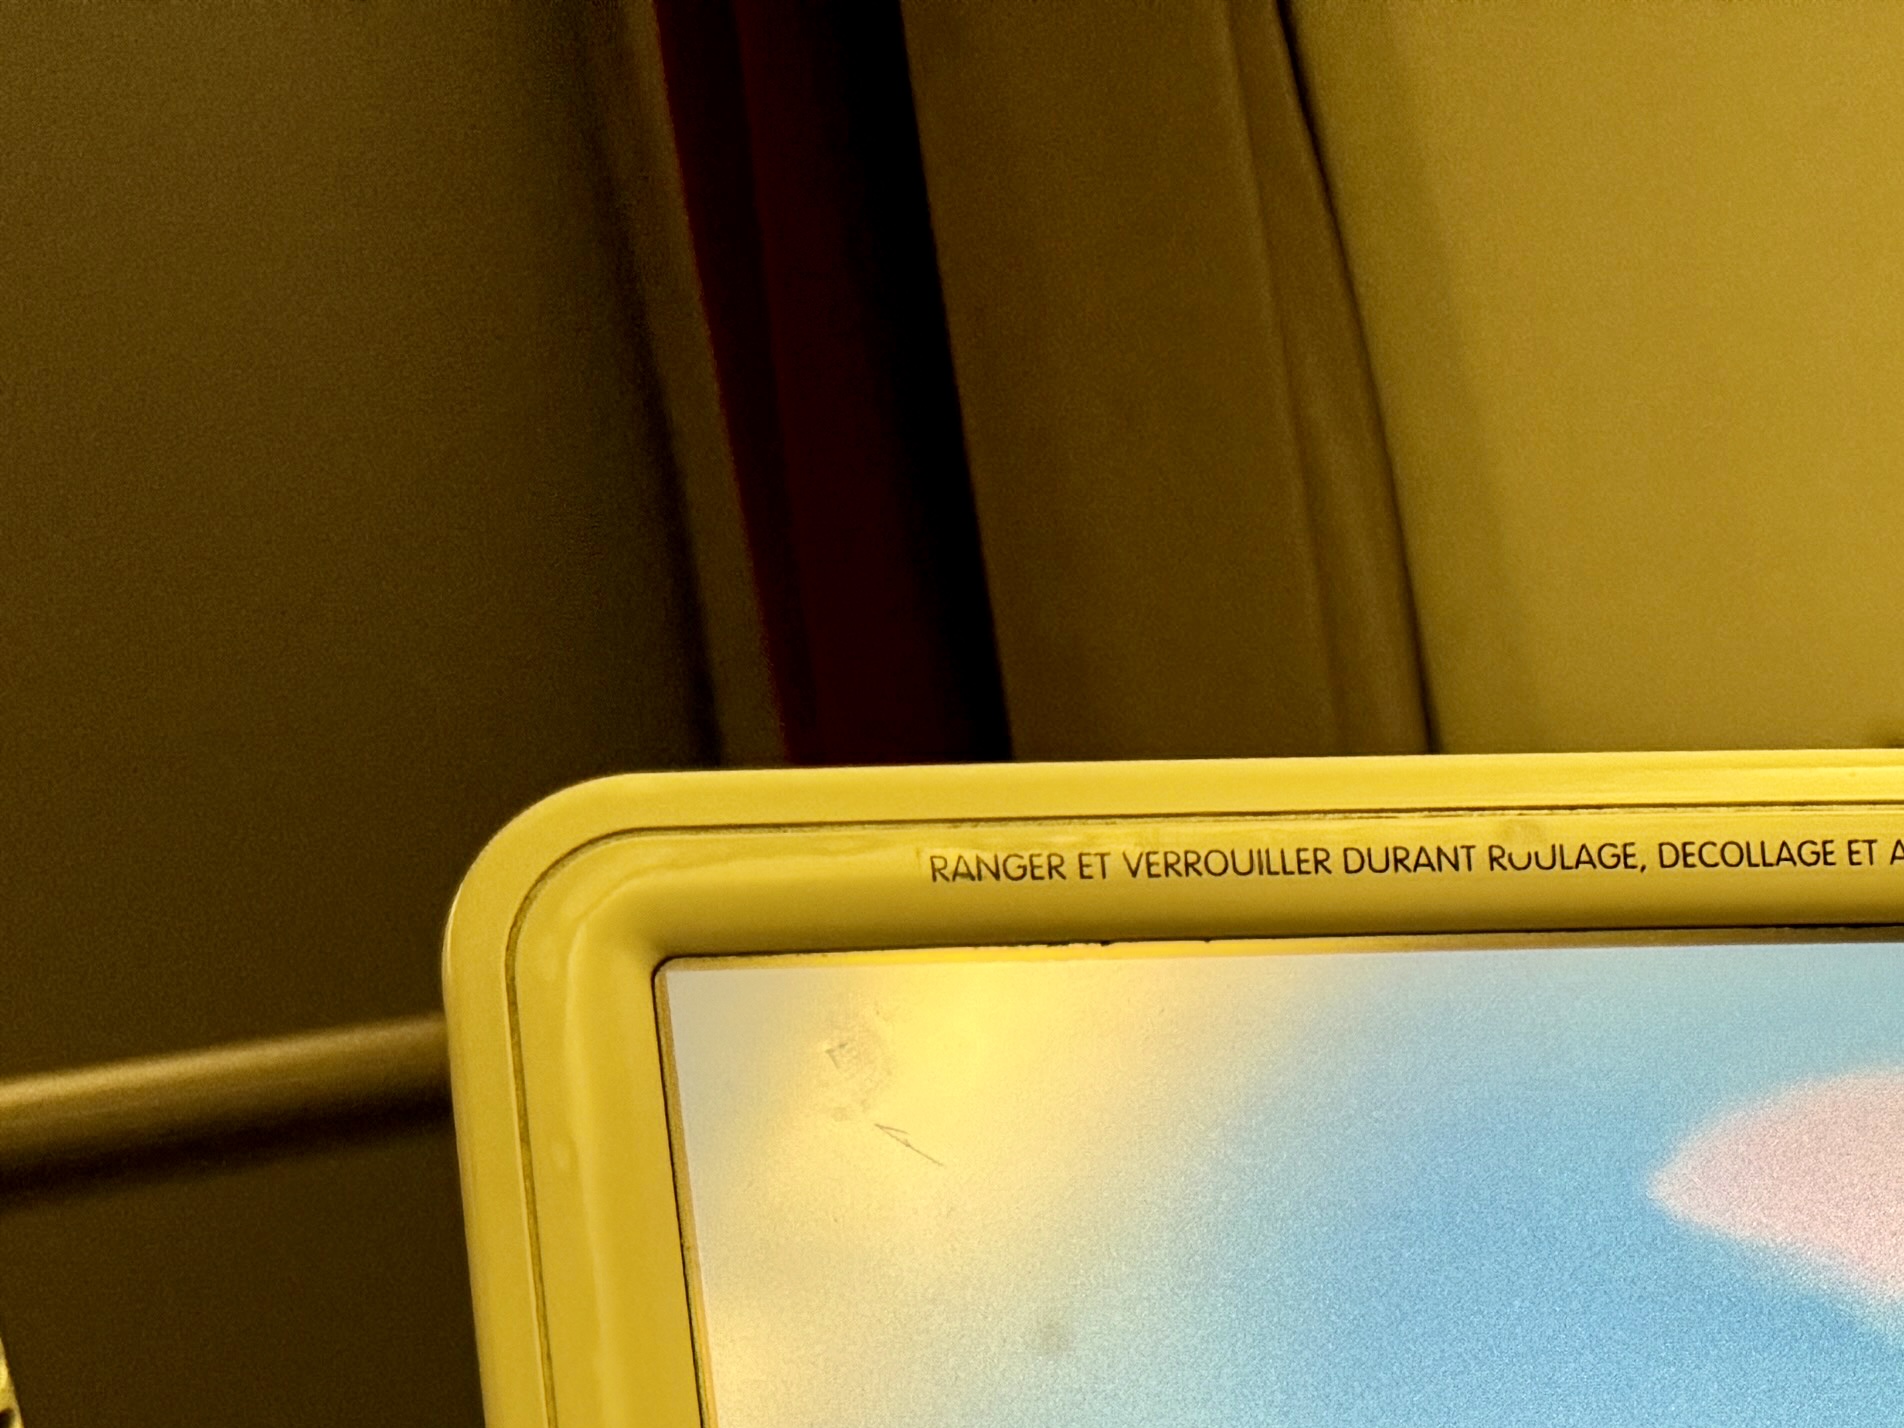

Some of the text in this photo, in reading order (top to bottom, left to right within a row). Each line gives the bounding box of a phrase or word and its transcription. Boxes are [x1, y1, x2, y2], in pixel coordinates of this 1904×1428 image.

[931, 853, 1067, 883] RANGER
[1078, 850, 1111, 880] ET
[1122, 847, 1332, 880] VERROUILLER
[1344, 844, 1476, 875] DURANT
[1660, 838, 1836, 869] DECOLLAGE
[1847, 837, 1877, 866] ET
